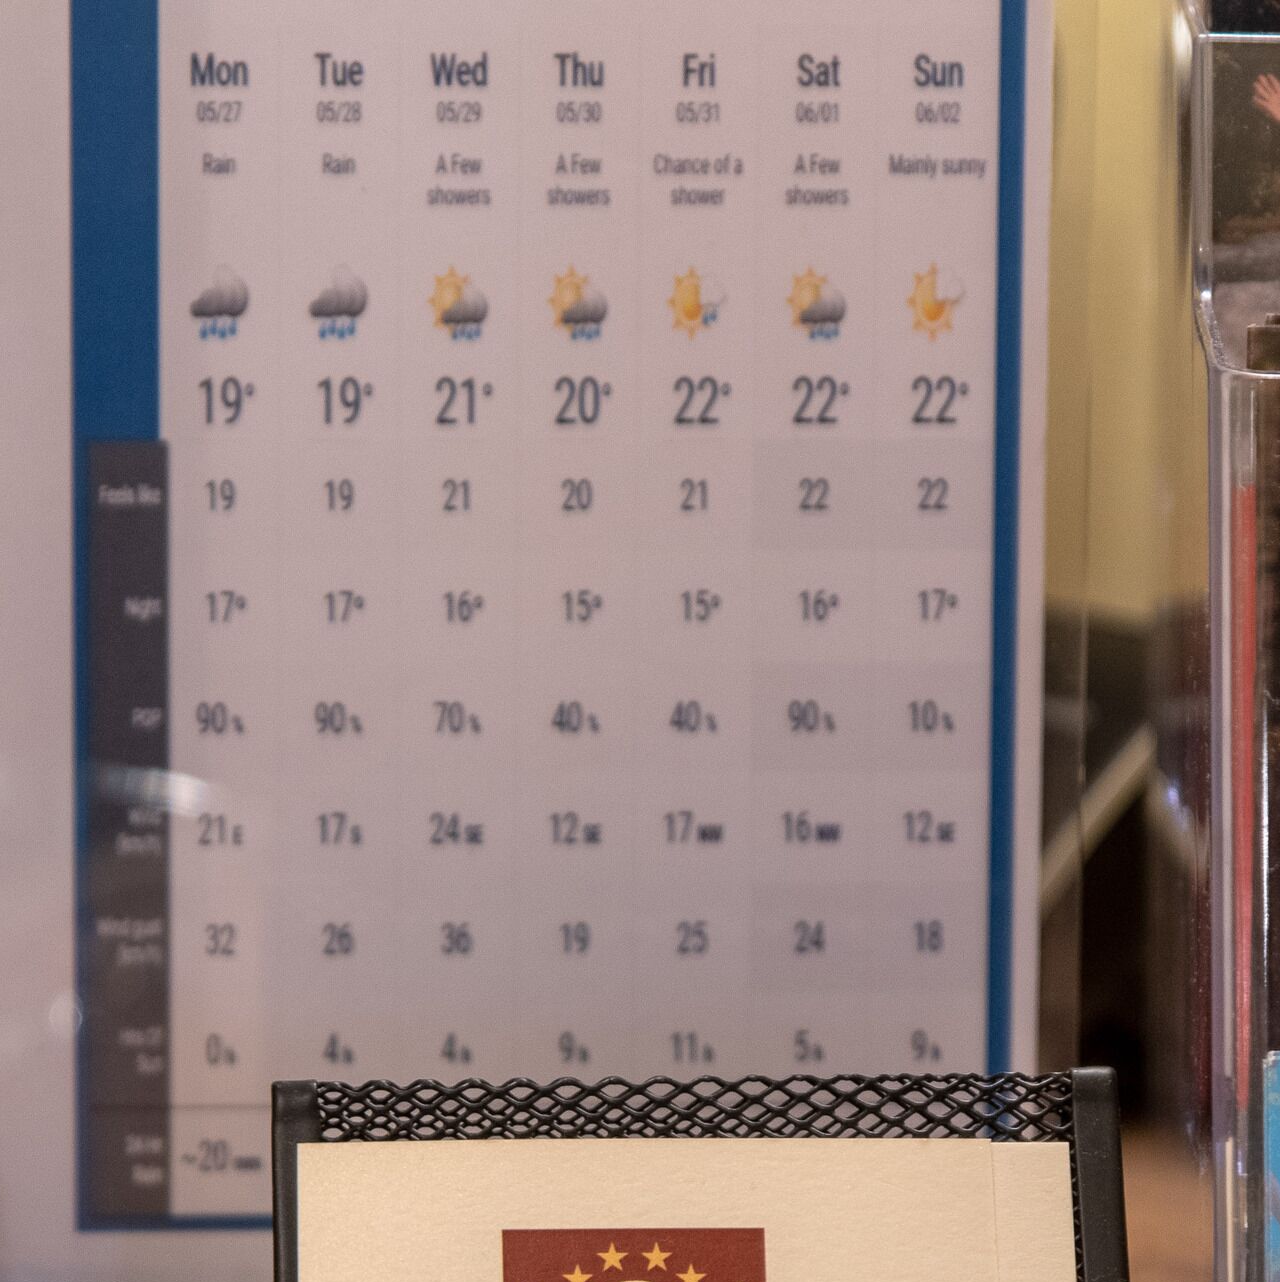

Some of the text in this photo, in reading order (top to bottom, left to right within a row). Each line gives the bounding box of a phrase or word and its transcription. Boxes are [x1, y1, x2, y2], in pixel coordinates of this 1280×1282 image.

[190, 53, 249, 87] Mon
[315, 53, 364, 86] Tue
[430, 52, 488, 87] Wed
[554, 52, 604, 87] Thu
[683, 53, 715, 87] Fri
[797, 54, 841, 87] Sat
[914, 54, 963, 87] Sun
[196, 101, 242, 123] 05/27
[316, 101, 362, 122] 05/28
[436, 101, 482, 122] 05/29
[556, 101, 602, 123] 05/30
[676, 101, 720, 123] 05/31
[796, 102, 839, 123] 06/01
[915, 102, 960, 123] 06/02
[202, 153, 236, 174] Rain
[322, 153, 356, 174] Rain
[436, 154, 482, 174] A Few
[555, 153, 602, 174] A Few
[794, 153, 840, 174] A Few
[199, 376, 255, 425] 19°
[318, 376, 373, 425] 19°
[435, 376, 493, 425] 21°
[554, 376, 612, 426] 20°
[673, 376, 731, 425] 22°
[792, 375, 850, 425] 22°
[911, 375, 969, 425] 22°
[205, 478, 237, 512] 19
[324, 478, 354, 512] 19
[442, 479, 470, 511] 21
[561, 478, 593, 511] 20
[680, 478, 708, 511] 21
[799, 477, 829, 511] 22
[918, 477, 949, 511] 22
